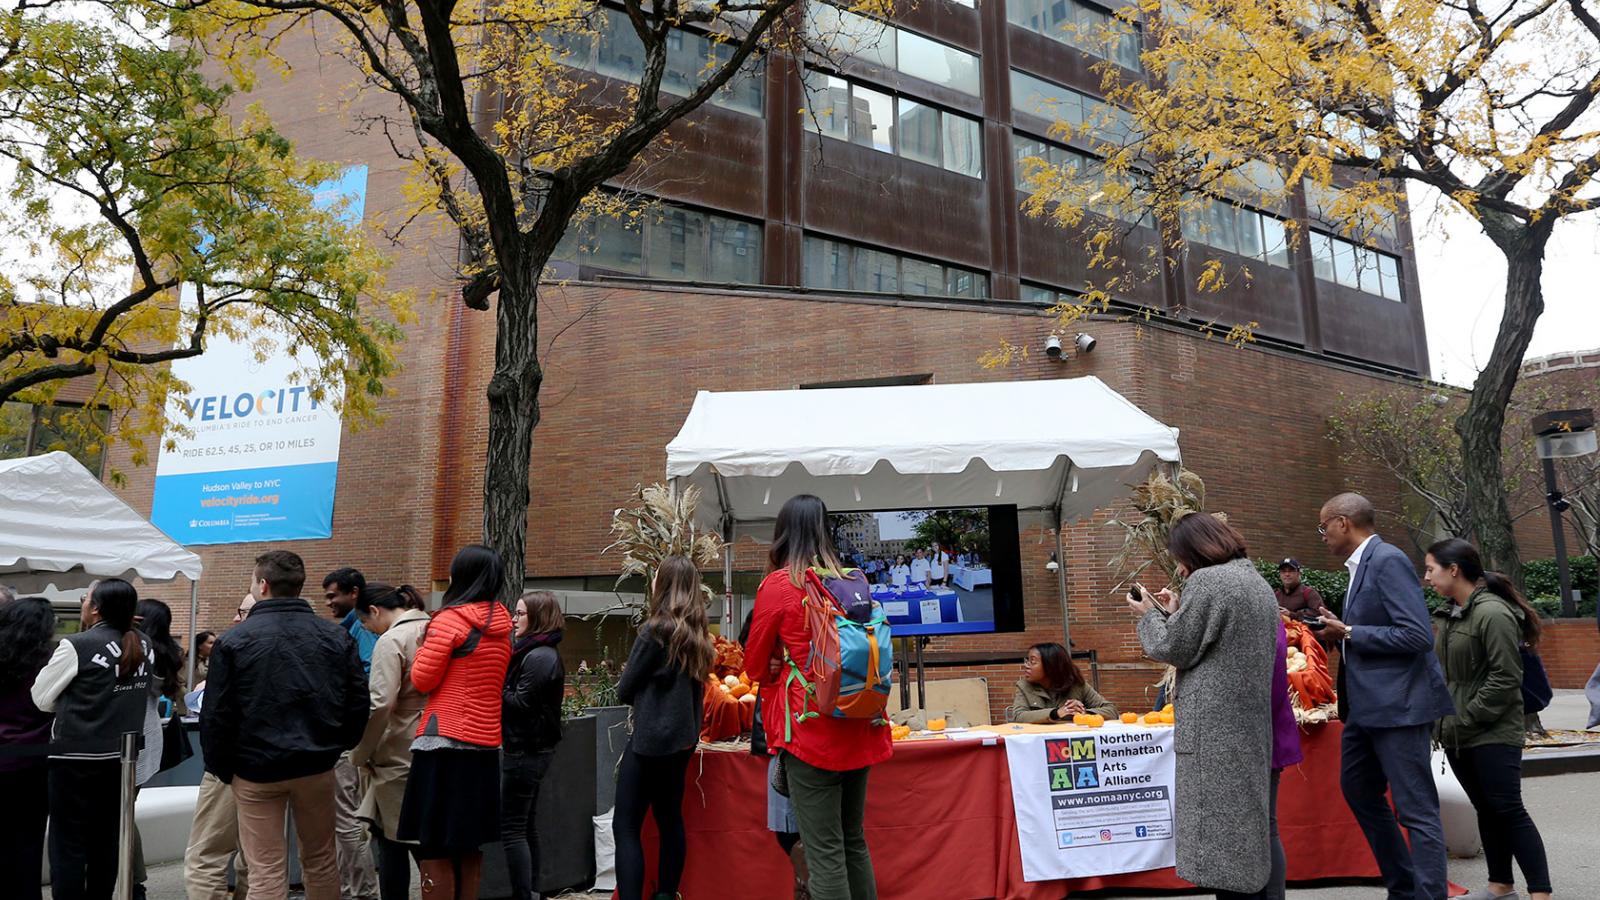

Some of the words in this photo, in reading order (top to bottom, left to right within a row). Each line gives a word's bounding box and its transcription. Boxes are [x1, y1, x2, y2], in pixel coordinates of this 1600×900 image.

[266, 418, 283, 426] END
[285, 414, 318, 423] CANCER
[183, 448, 205, 459] RIDE
[228, 444, 242, 456] 45,
[259, 442, 273, 451] OR
[276, 440, 286, 450] 10
[288, 438, 316, 449] MILES
[202, 482, 230, 492] Hudson
[231, 480, 253, 491] Valley
[254, 480, 263, 489] to
[263, 479, 281, 488] NYC
[1099, 732, 1153, 745] Northern
[1101, 745, 1163, 758] Manhattan
[1102, 761, 1127, 772] Arts
[1104, 774, 1151, 786] Alliance
[1057, 789, 1164, 807] www.nomaanyc.org
